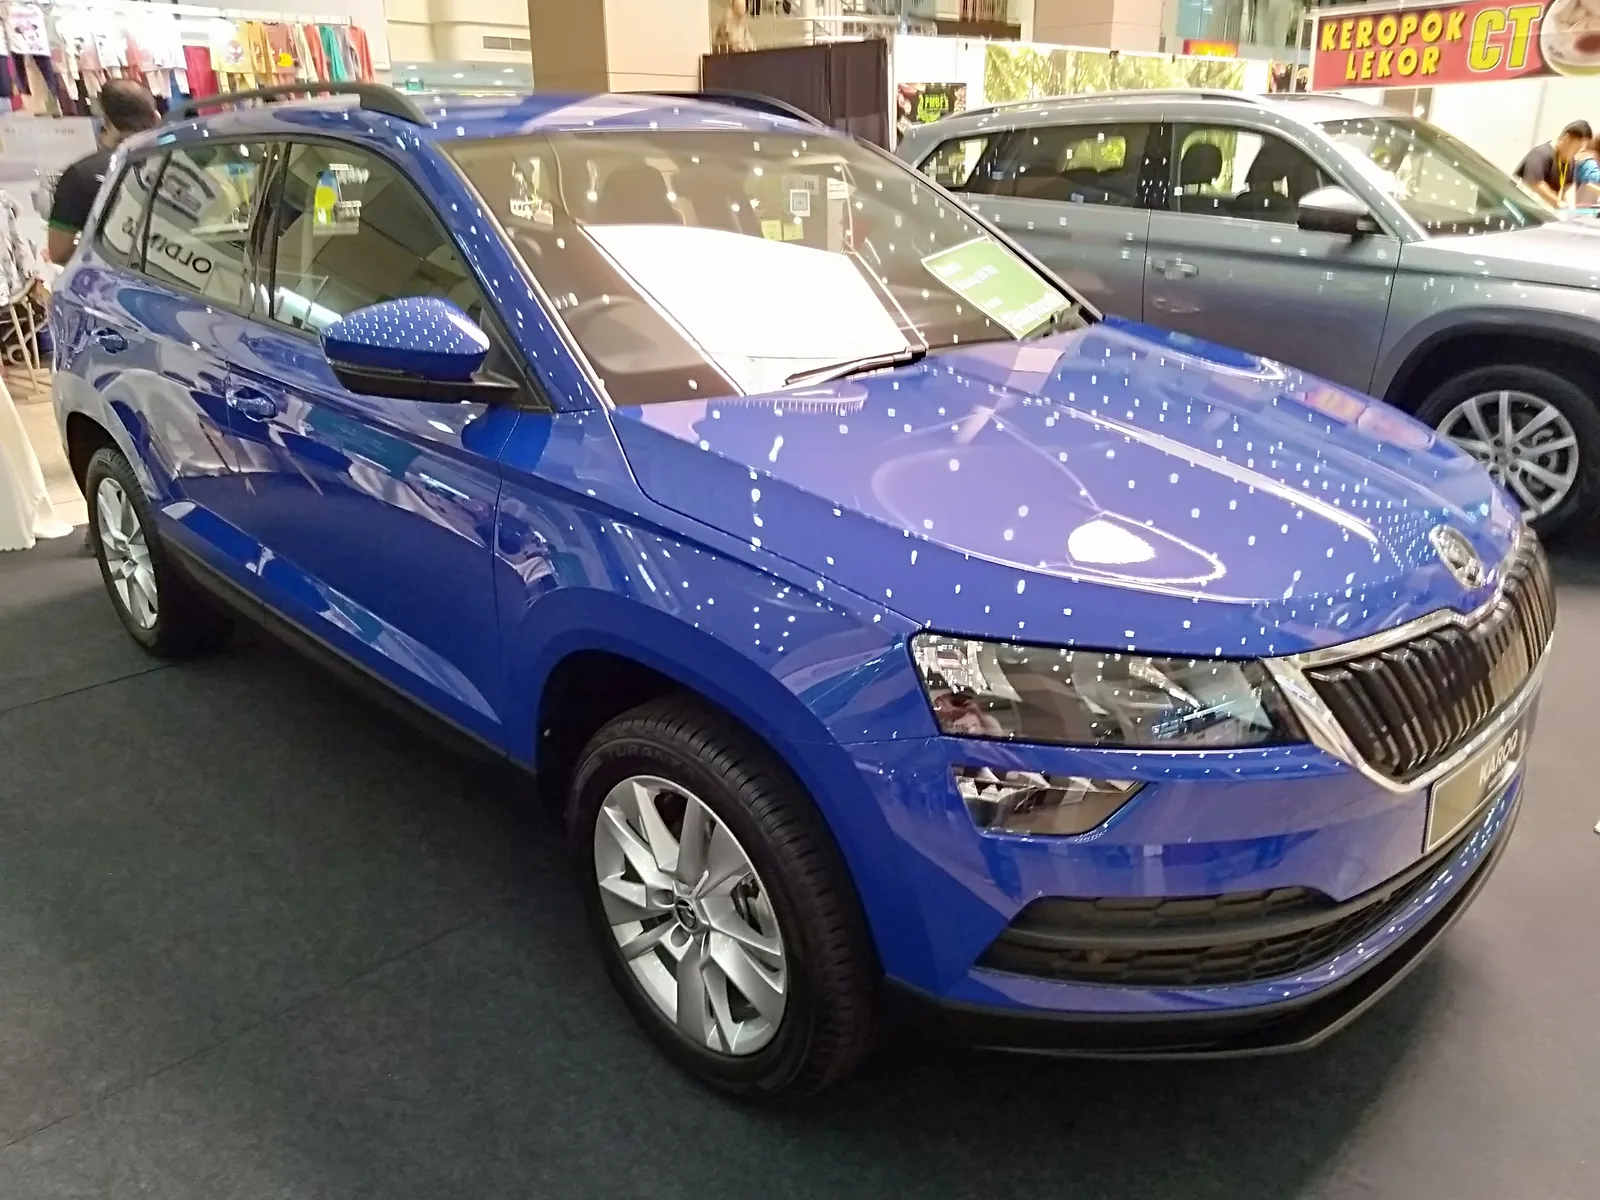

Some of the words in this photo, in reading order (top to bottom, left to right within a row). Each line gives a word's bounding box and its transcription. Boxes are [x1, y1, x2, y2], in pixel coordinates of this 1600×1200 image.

[1321, 10, 1467, 52] KEROPOK
[1468, 5, 1543, 72] CT
[1345, 45, 1440, 80] LEKOR
